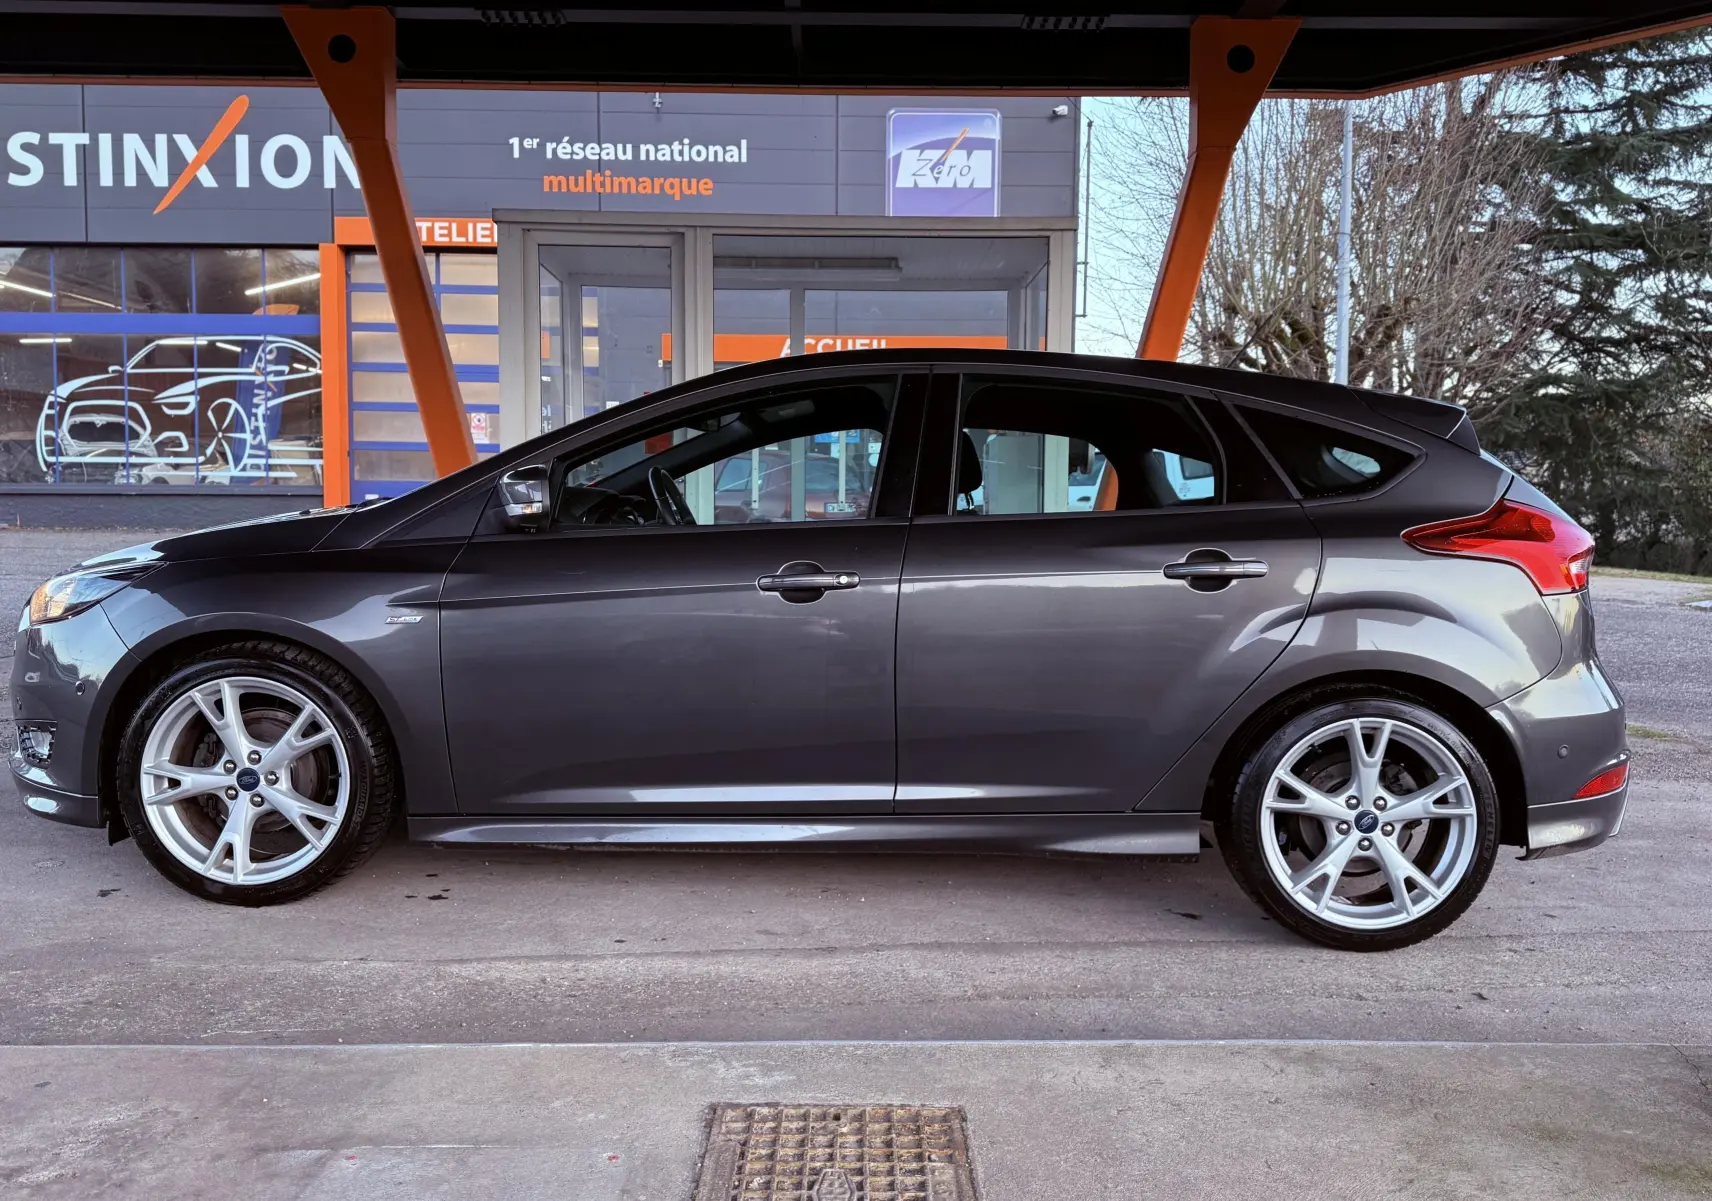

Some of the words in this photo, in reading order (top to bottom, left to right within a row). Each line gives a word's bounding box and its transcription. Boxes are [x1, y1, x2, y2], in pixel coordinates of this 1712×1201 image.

[508, 137, 539, 159] 1er
[545, 136, 633, 160] réseau
[640, 138, 748, 163] national
[895, 149, 992, 188] KM
[911, 158, 971, 177] Zero
[543, 169, 714, 200] multimarque
[415, 221, 498, 243] TELIE
